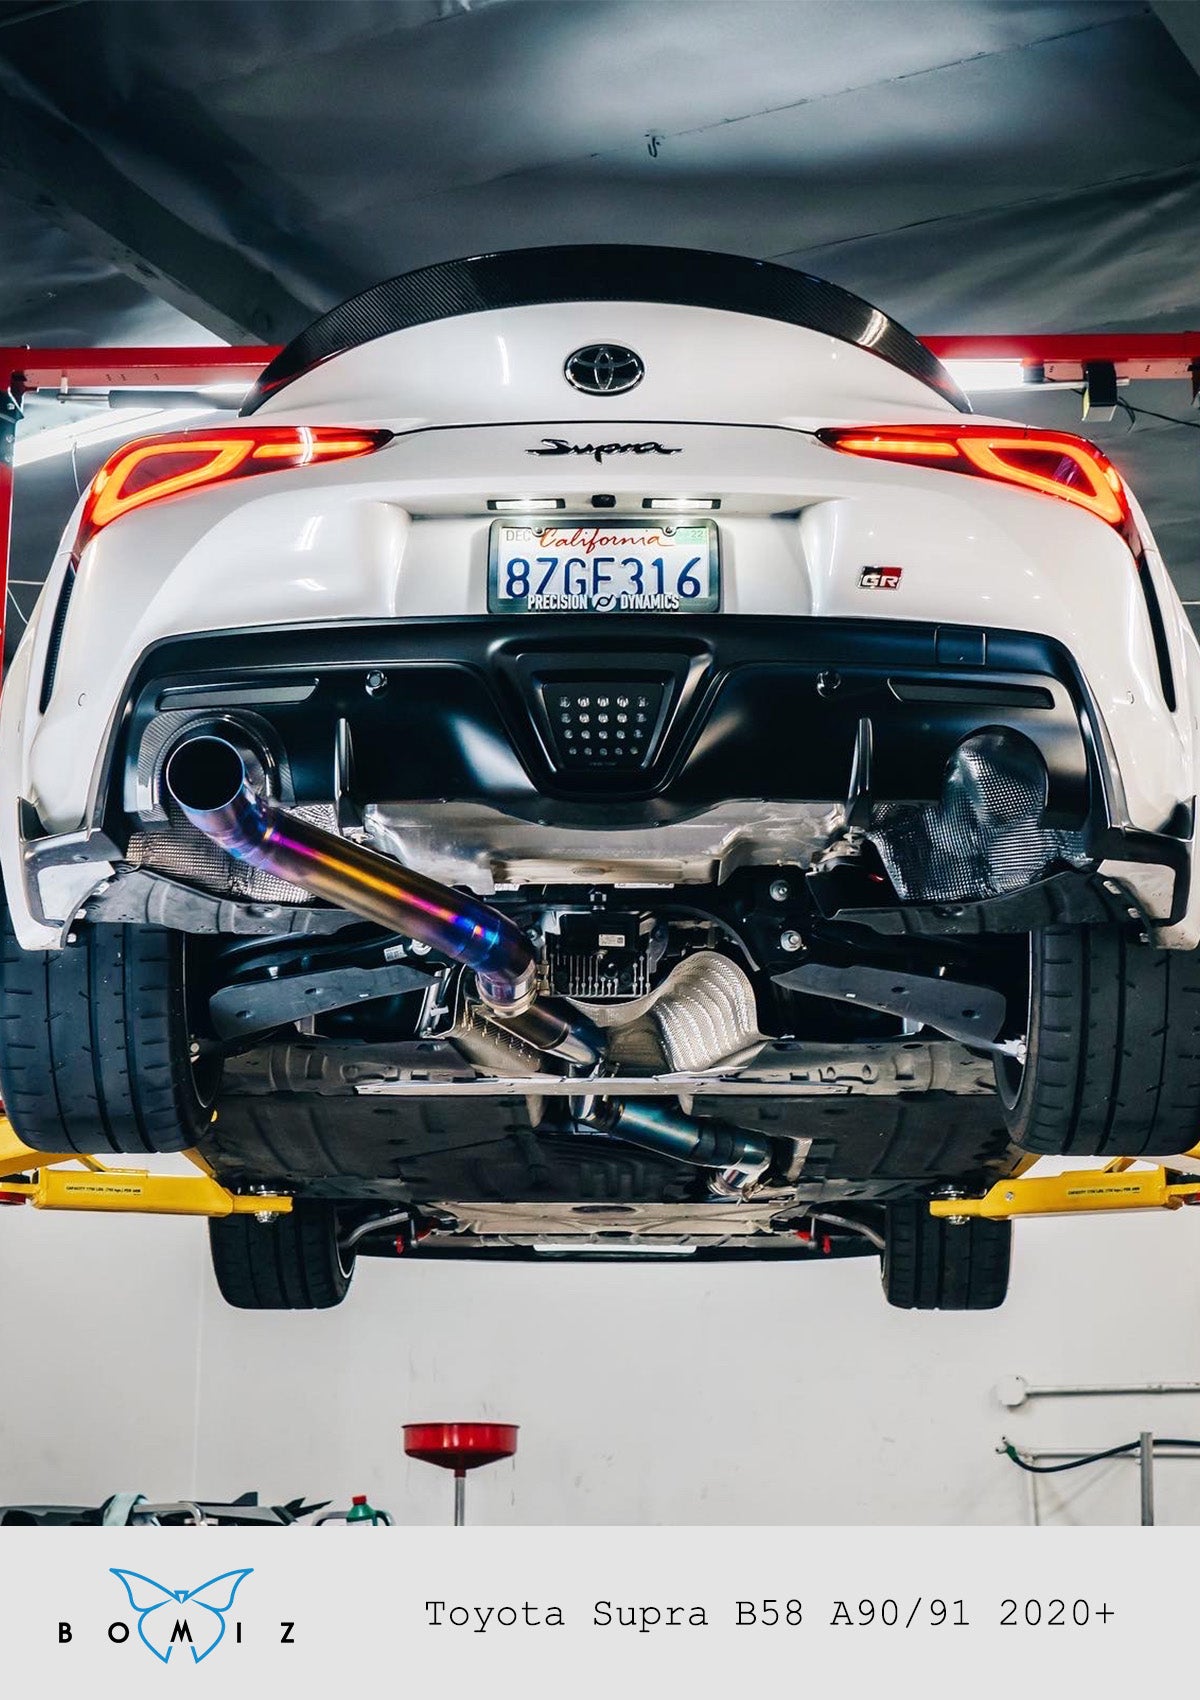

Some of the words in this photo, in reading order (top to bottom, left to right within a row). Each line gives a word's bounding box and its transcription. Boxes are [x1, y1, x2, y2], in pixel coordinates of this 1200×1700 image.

[526, 438, 682, 463] Supra
[506, 529, 531, 541] DEC
[539, 527, 674, 554] California
[861, 574, 899, 587] GR
[527, 594, 588, 610] PRECISION
[620, 594, 680, 610] DYNAMICS
